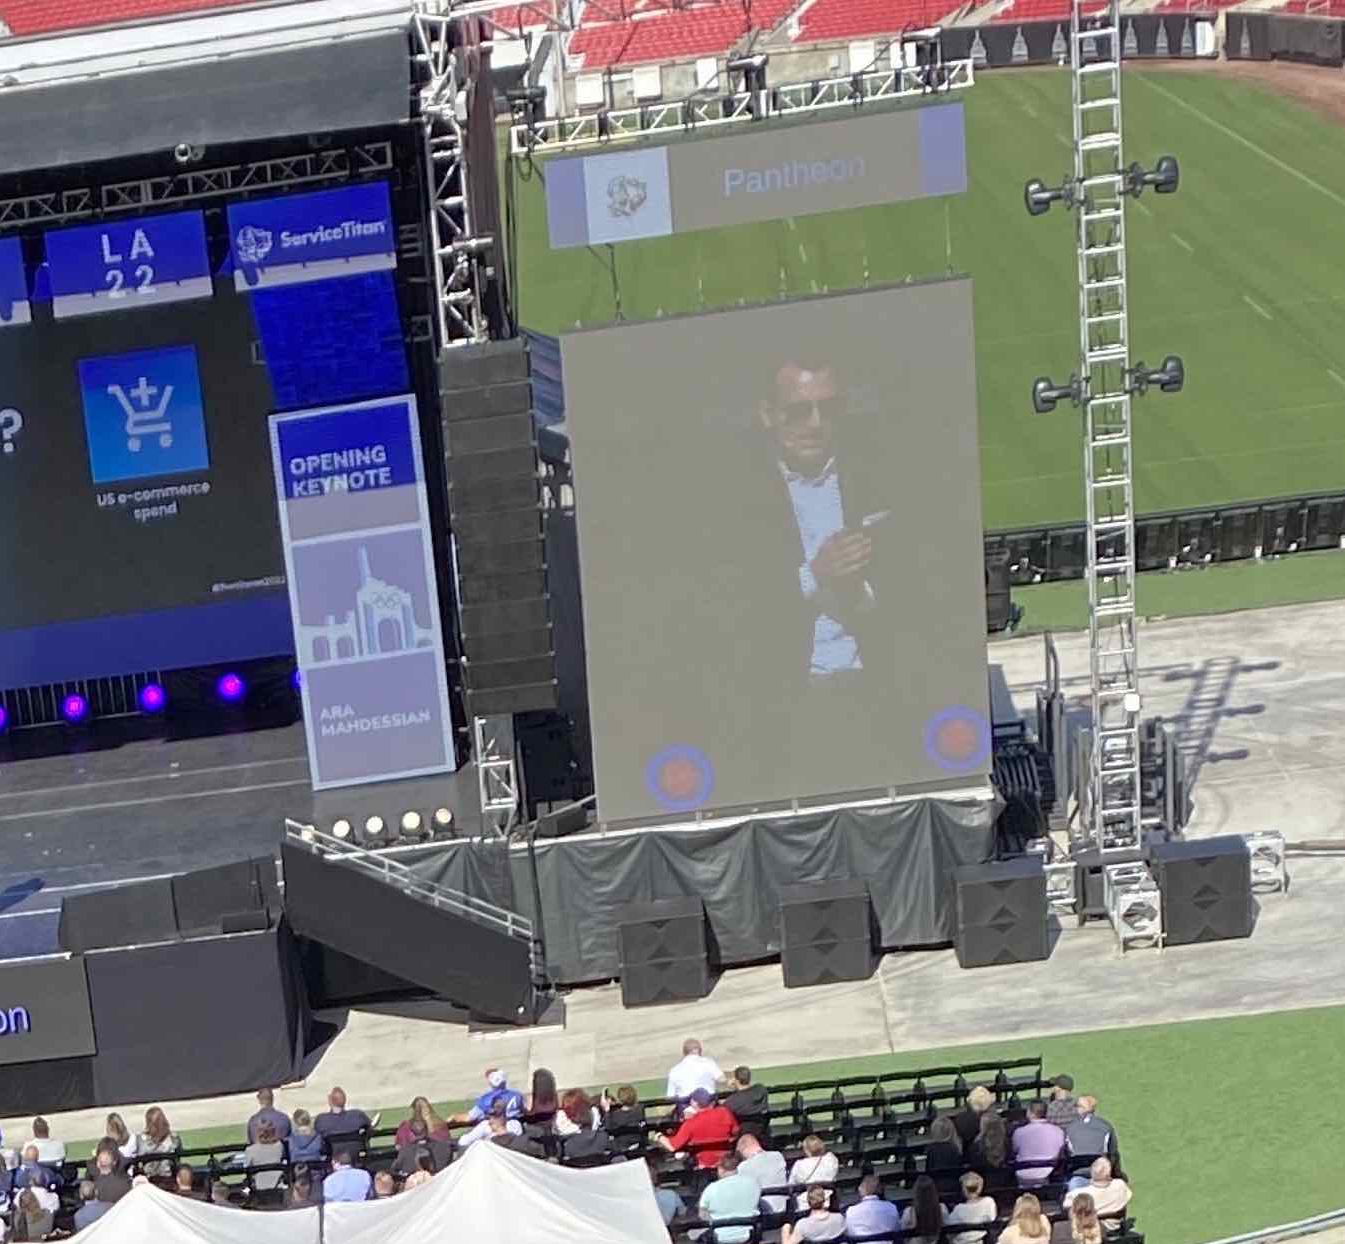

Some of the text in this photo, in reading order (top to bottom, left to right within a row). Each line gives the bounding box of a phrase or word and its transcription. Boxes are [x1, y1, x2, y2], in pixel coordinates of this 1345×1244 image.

[722, 156, 866, 197] Pantheon
[280, 219, 386, 248] ServiceTitan
[289, 444, 387, 475] OPENING
[96, 480, 211, 507] US e-commerce
[292, 466, 392, 498] KEYNOTE
[133, 501, 178, 523] spend
[319, 703, 355, 722] ARA
[320, 708, 432, 737] MAHDESSIAN
